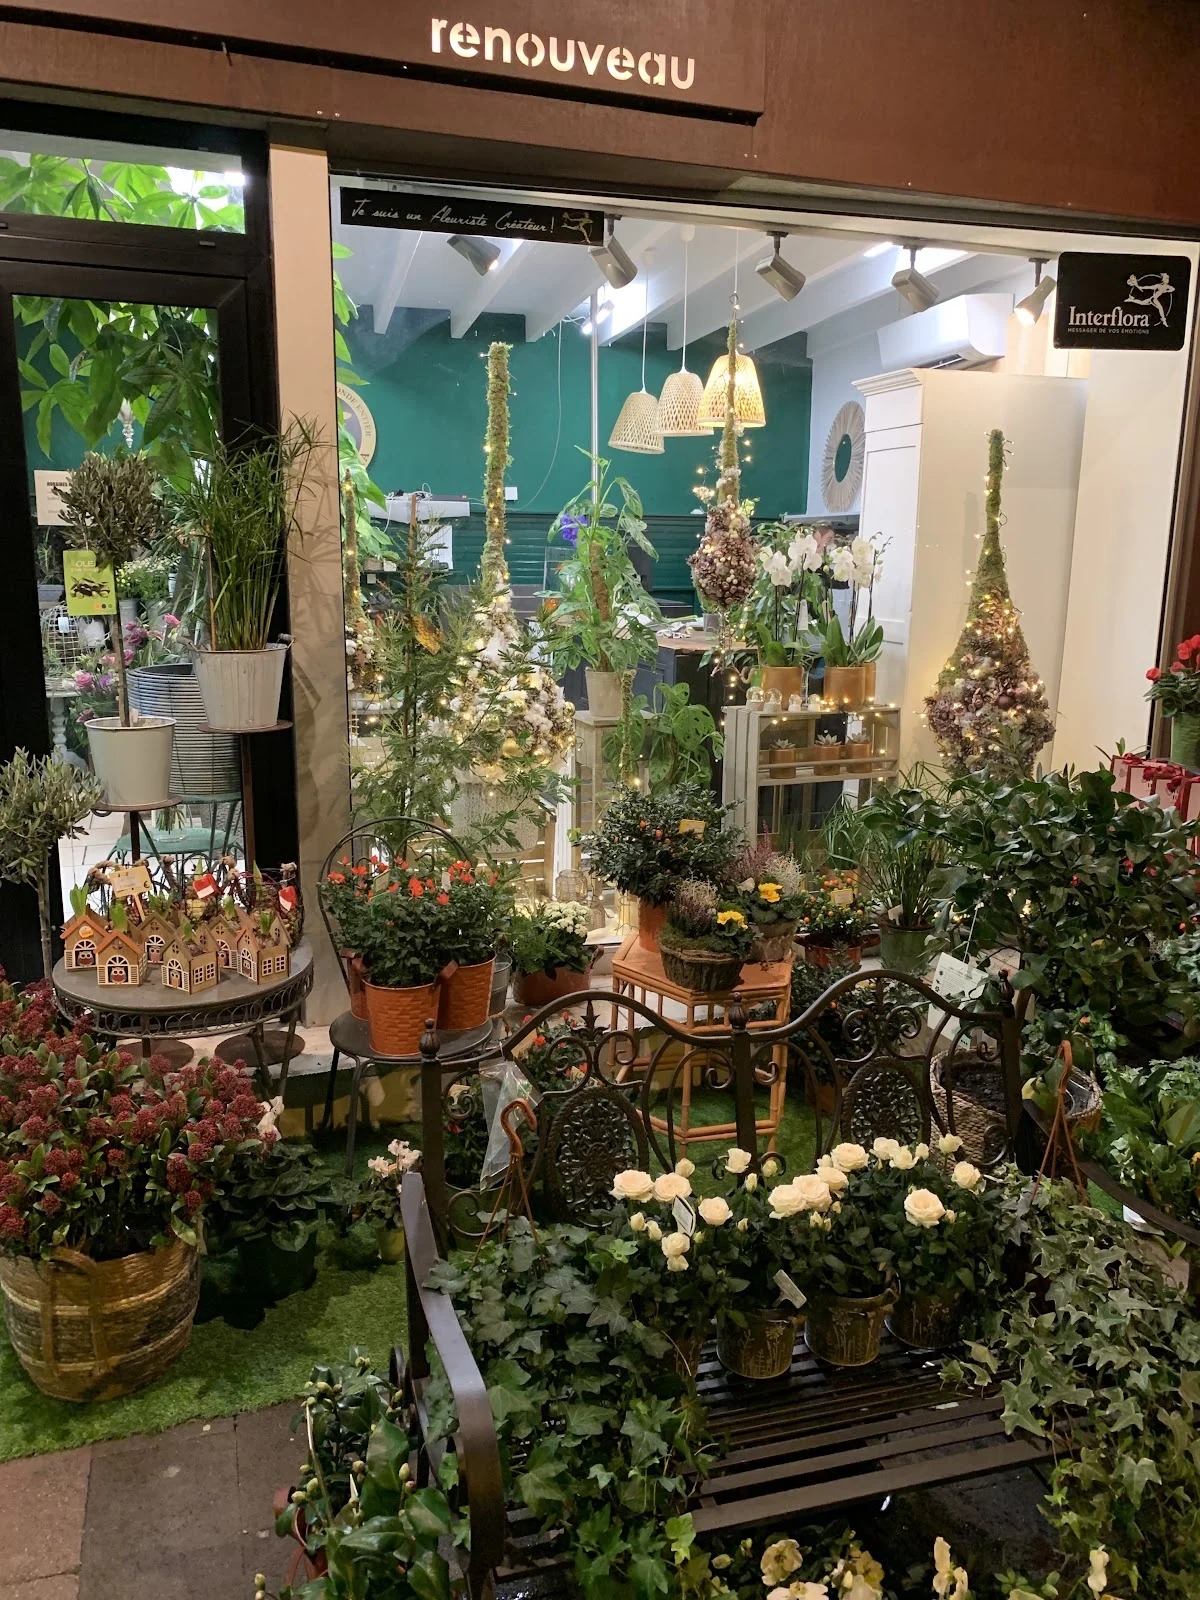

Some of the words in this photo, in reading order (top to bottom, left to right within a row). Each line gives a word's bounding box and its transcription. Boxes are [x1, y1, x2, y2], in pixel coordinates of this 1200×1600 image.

[431, 18, 695, 89] renouveau
[352, 198, 372, 217] Je
[372, 208, 400, 219] suis
[1068, 306, 1150, 327] Interflora
[75, 560, 96, 568] OLE
